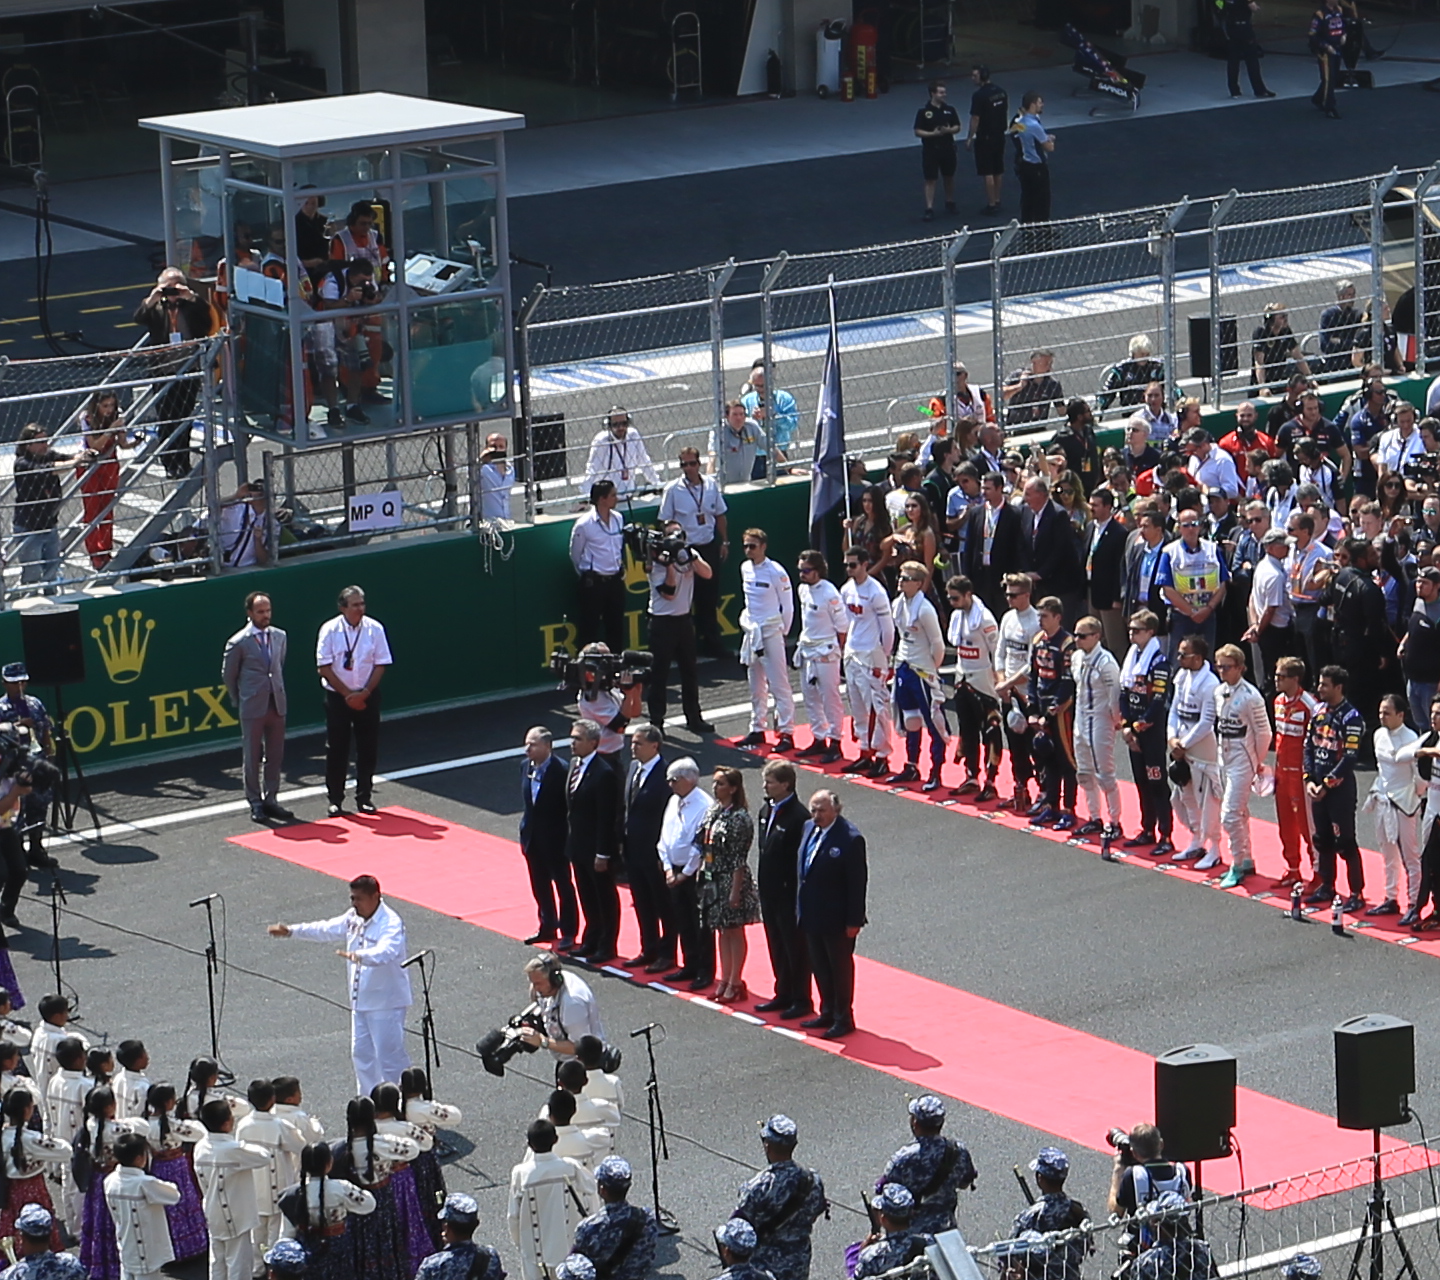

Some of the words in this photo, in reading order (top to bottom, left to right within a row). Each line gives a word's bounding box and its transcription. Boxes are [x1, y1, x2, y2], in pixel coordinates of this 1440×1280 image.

[351, 504, 374, 522] MP
[382, 502, 395, 518] Q
[48, 685, 239, 758] OLEX
